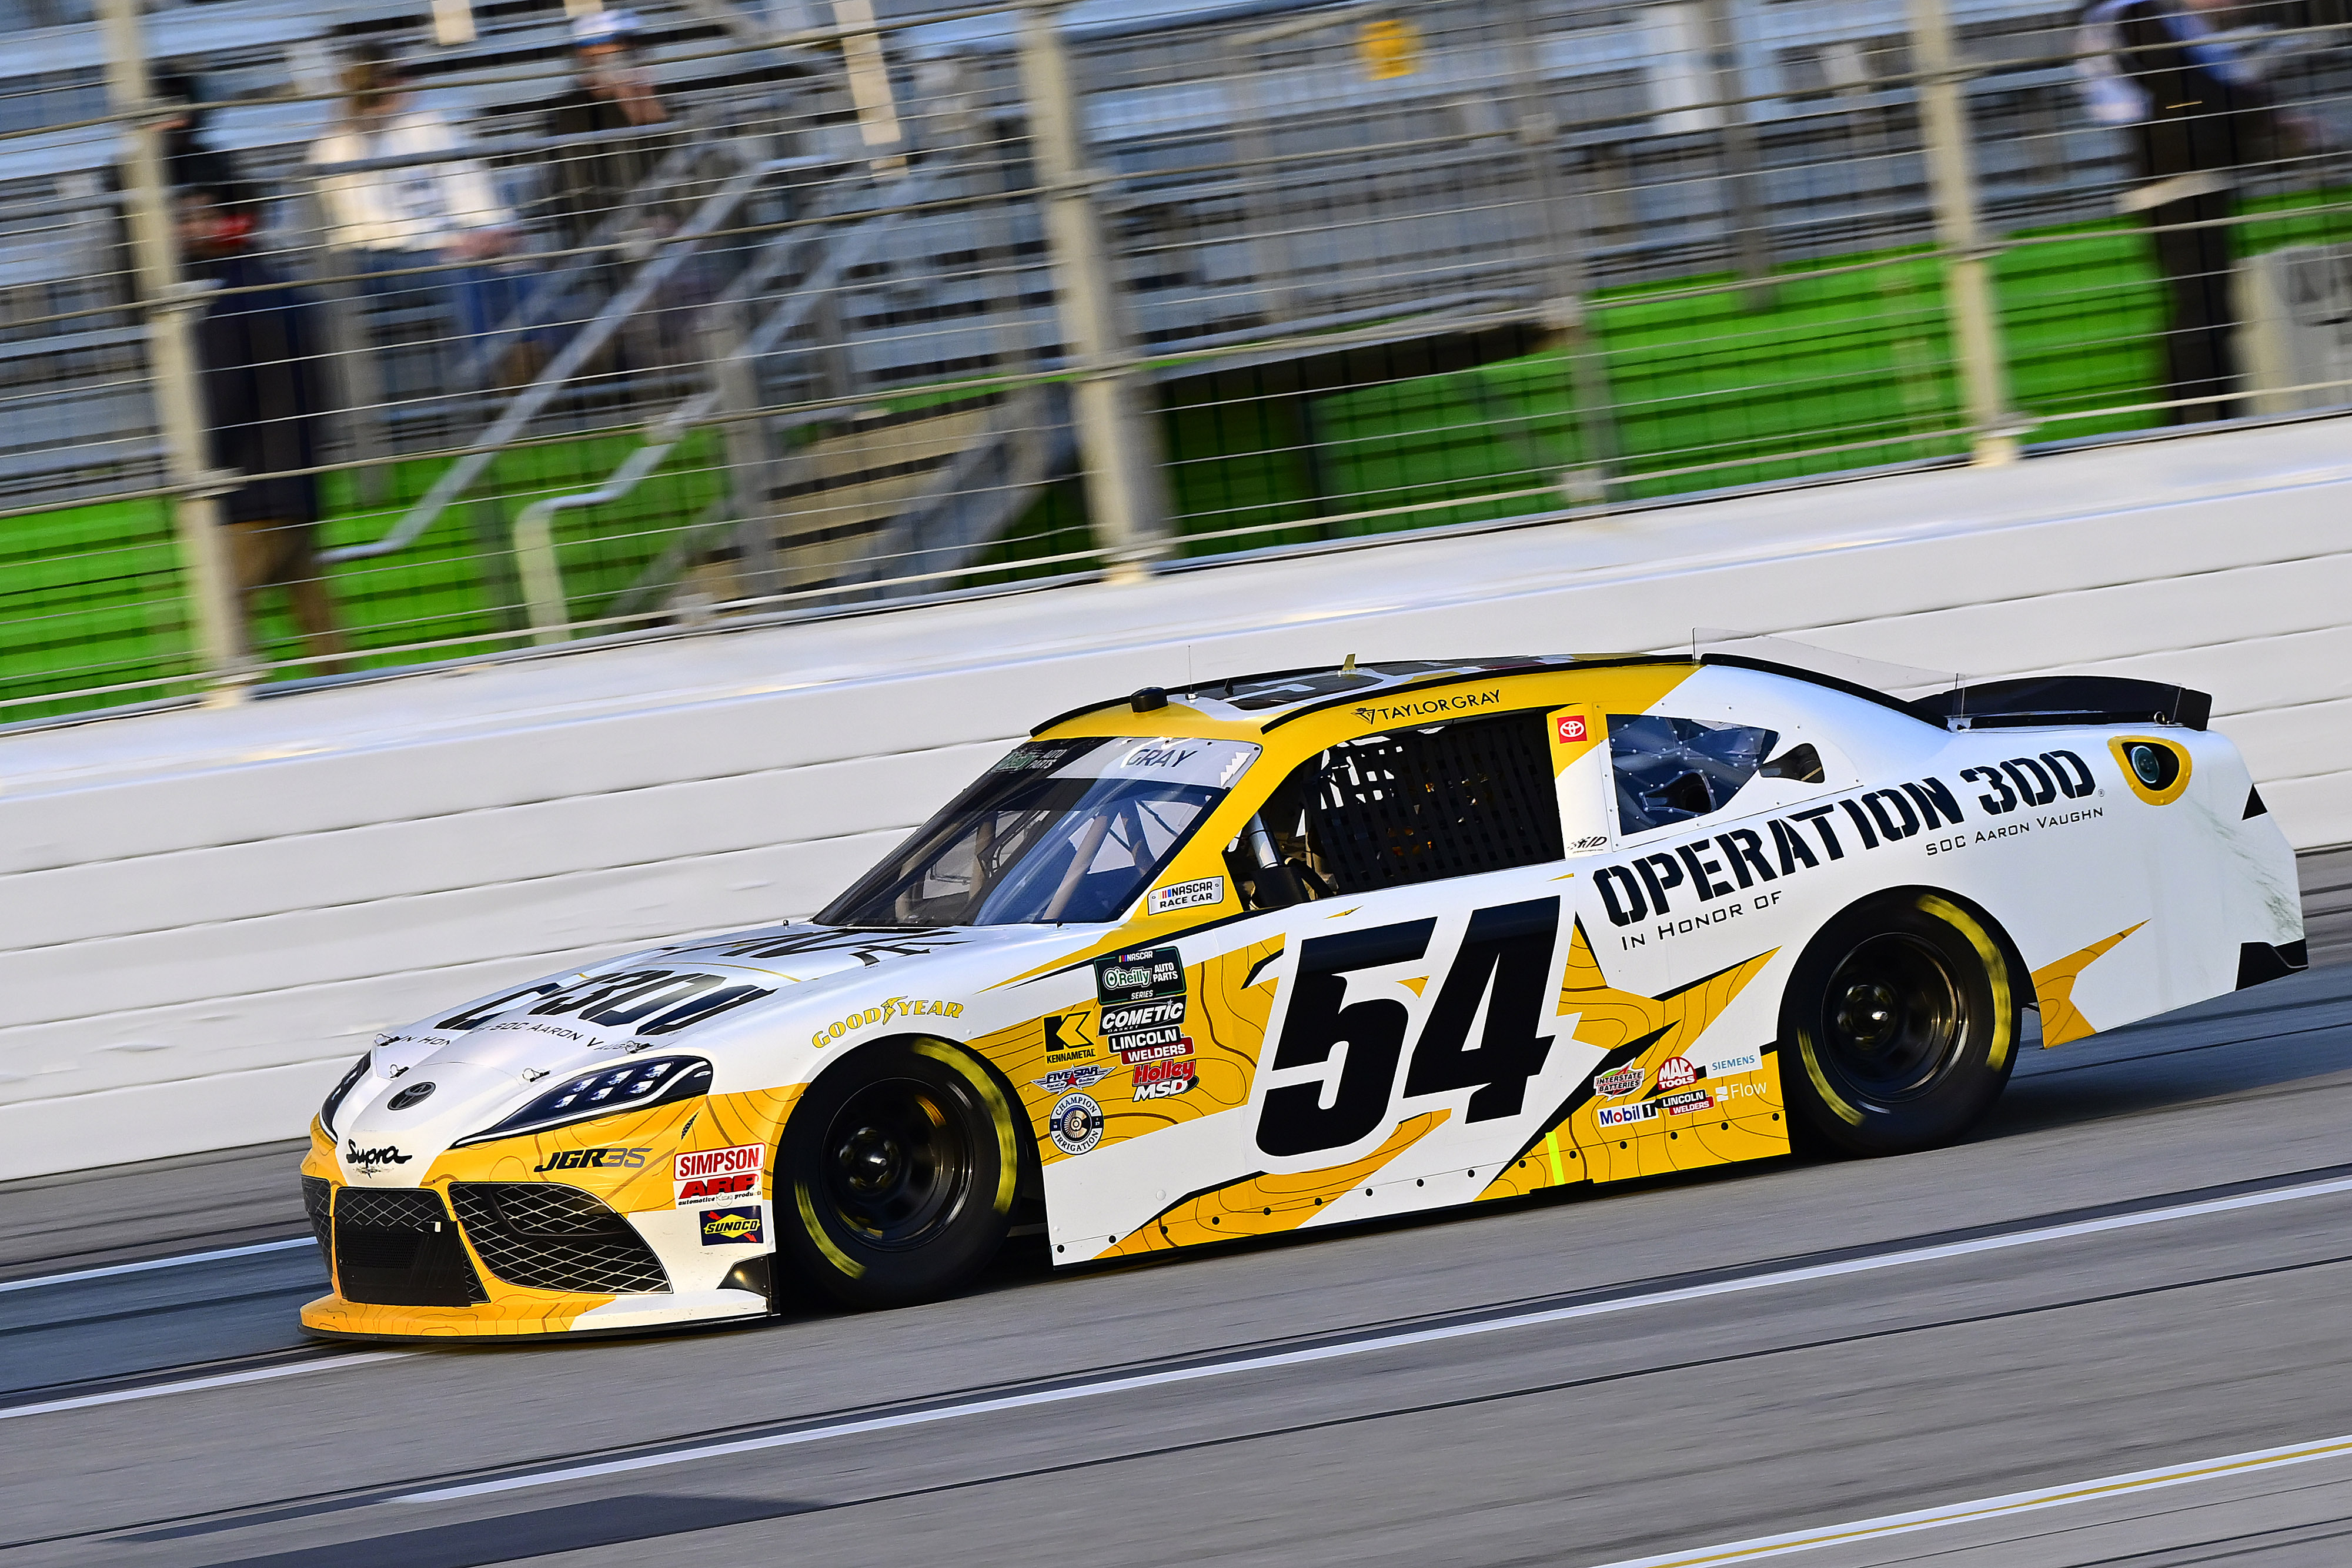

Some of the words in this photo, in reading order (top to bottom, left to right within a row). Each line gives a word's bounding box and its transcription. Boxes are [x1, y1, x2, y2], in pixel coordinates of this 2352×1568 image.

[1025, 758, 1057, 769] PARTS
[1125, 748, 1198, 768] GRAY
[1593, 775, 1965, 927] OPERATION
[1959, 750, 2096, 814] 300
[1926, 835, 1966, 856] SOC
[1975, 822, 2030, 844] AARON
[2036, 807, 2103, 828] VAUGHN
[1171, 881, 1212, 897] NASCAR
[1160, 896, 1188, 908] RACE
[1191, 892, 1212, 902] CAR
[1621, 933, 1646, 951] IN
[1657, 903, 1744, 940] HONOR
[1753, 890, 1782, 910] OF
[1127, 951, 1153, 962] NASCAR
[1153, 971, 1178, 982] PARTS
[1154, 962, 1175, 973] AUTO
[1105, 969, 1150, 988] O'Reilly
[1131, 989, 1154, 999] SERIES
[812, 998, 964, 1048] GOODYEAR
[1102, 1002, 1184, 1029] COMETIC
[1107, 1025, 1139, 1033] GASKET
[1255, 895, 1560, 1156] 54
[1111, 1029, 1177, 1051] LINCOLN
[1047, 1049, 1096, 1064] KENNAMETAL
[1128, 1044, 1186, 1062] WELDERS
[1133, 1059, 1196, 1084] Holley
[1659, 1058, 1694, 1082] MAC
[1712, 1055, 1755, 1071] SIEMENS
[1047, 1071, 1071, 1084] FIVE
[1073, 1066, 1098, 1076] STAR
[1596, 1071, 1642, 1085] INTERSTATE
[1659, 1076, 1695, 1089] TOOLS
[1132, 1079, 1188, 1102] MSD
[1599, 1080, 1640, 1092] BATTERIES
[1730, 1082, 1766, 1099] Flow
[1055, 1096, 1098, 1116] CHAMPION
[1662, 1091, 1704, 1107] LINCOLN
[1673, 1101, 1710, 1114] WELDERS
[1599, 1105, 1641, 1125] Mobil
[1645, 1104, 1652, 1117] 1
[1055, 1129, 1100, 1152] IRRIGATION
[346, 1138, 413, 1178] Supra
[679, 1148, 760, 1177] SIMPSON
[678, 1174, 760, 1199] ARP
[678, 1197, 716, 1206] automotive
[706, 1220, 758, 1233] SUNOCO
